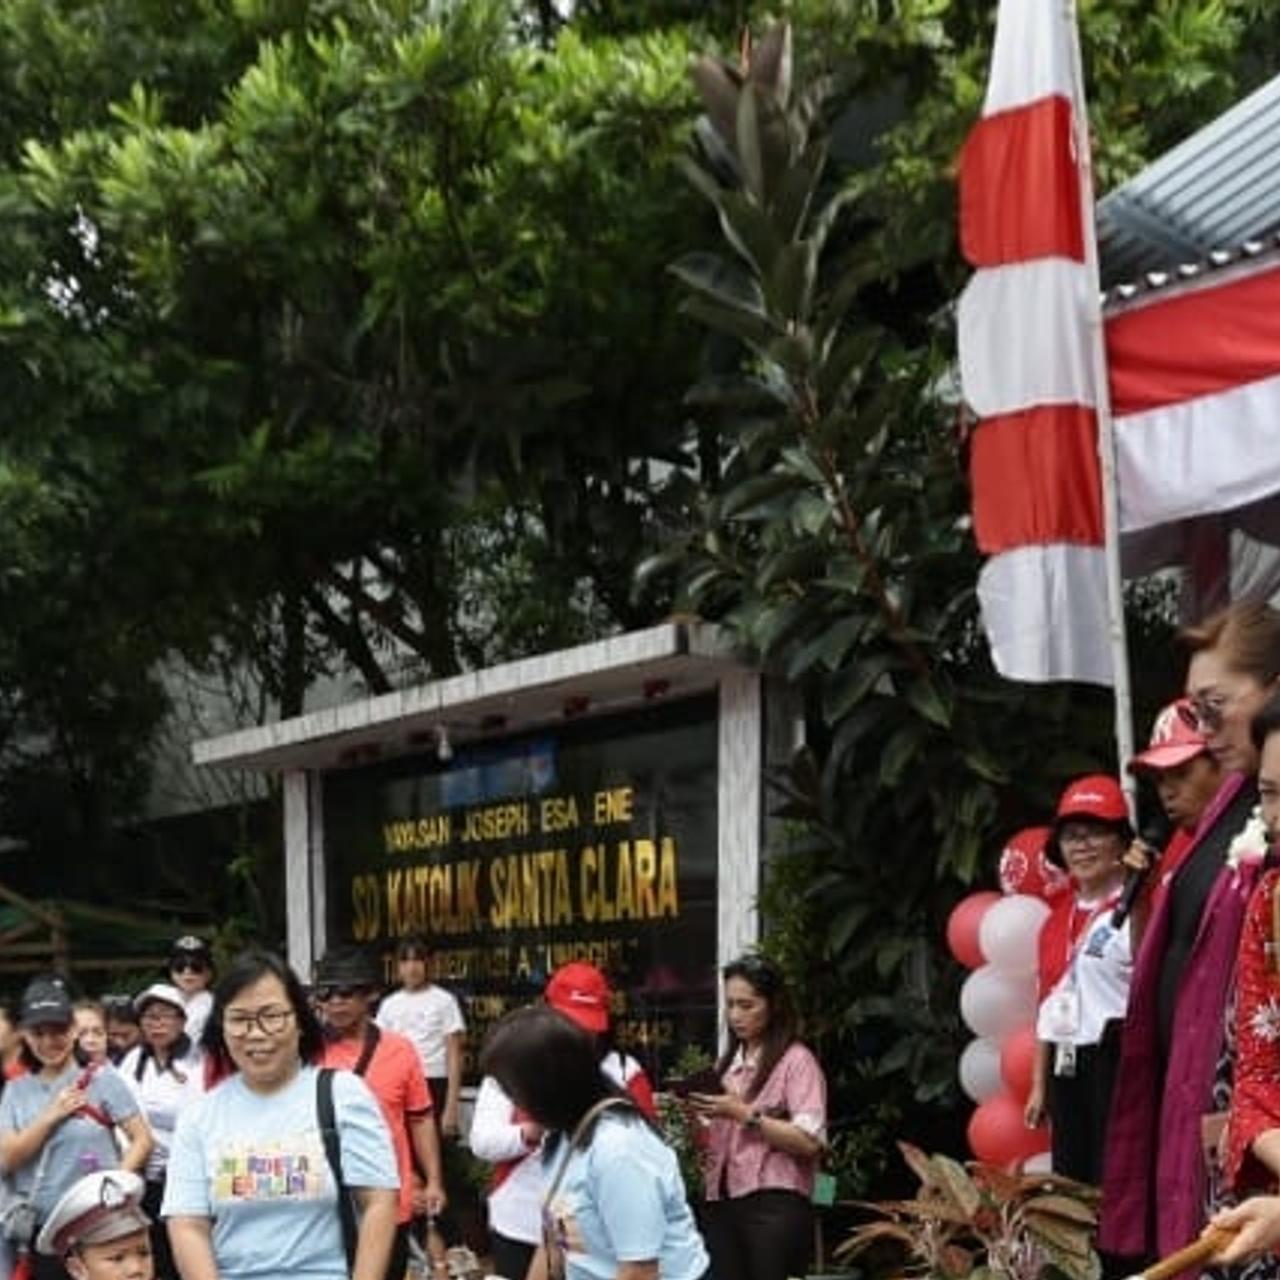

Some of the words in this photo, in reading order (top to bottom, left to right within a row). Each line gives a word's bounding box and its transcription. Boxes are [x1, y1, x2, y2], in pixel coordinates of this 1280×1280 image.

[461, 803, 529, 842] JOSEPH
[540, 796, 580, 832] ESA
[594, 787, 634, 824] ENE
[352, 875, 380, 941] SD
[387, 857, 482, 940] KATOLIK
[489, 848, 573, 930] SANTA
[579, 836, 678, 922] CLARA
